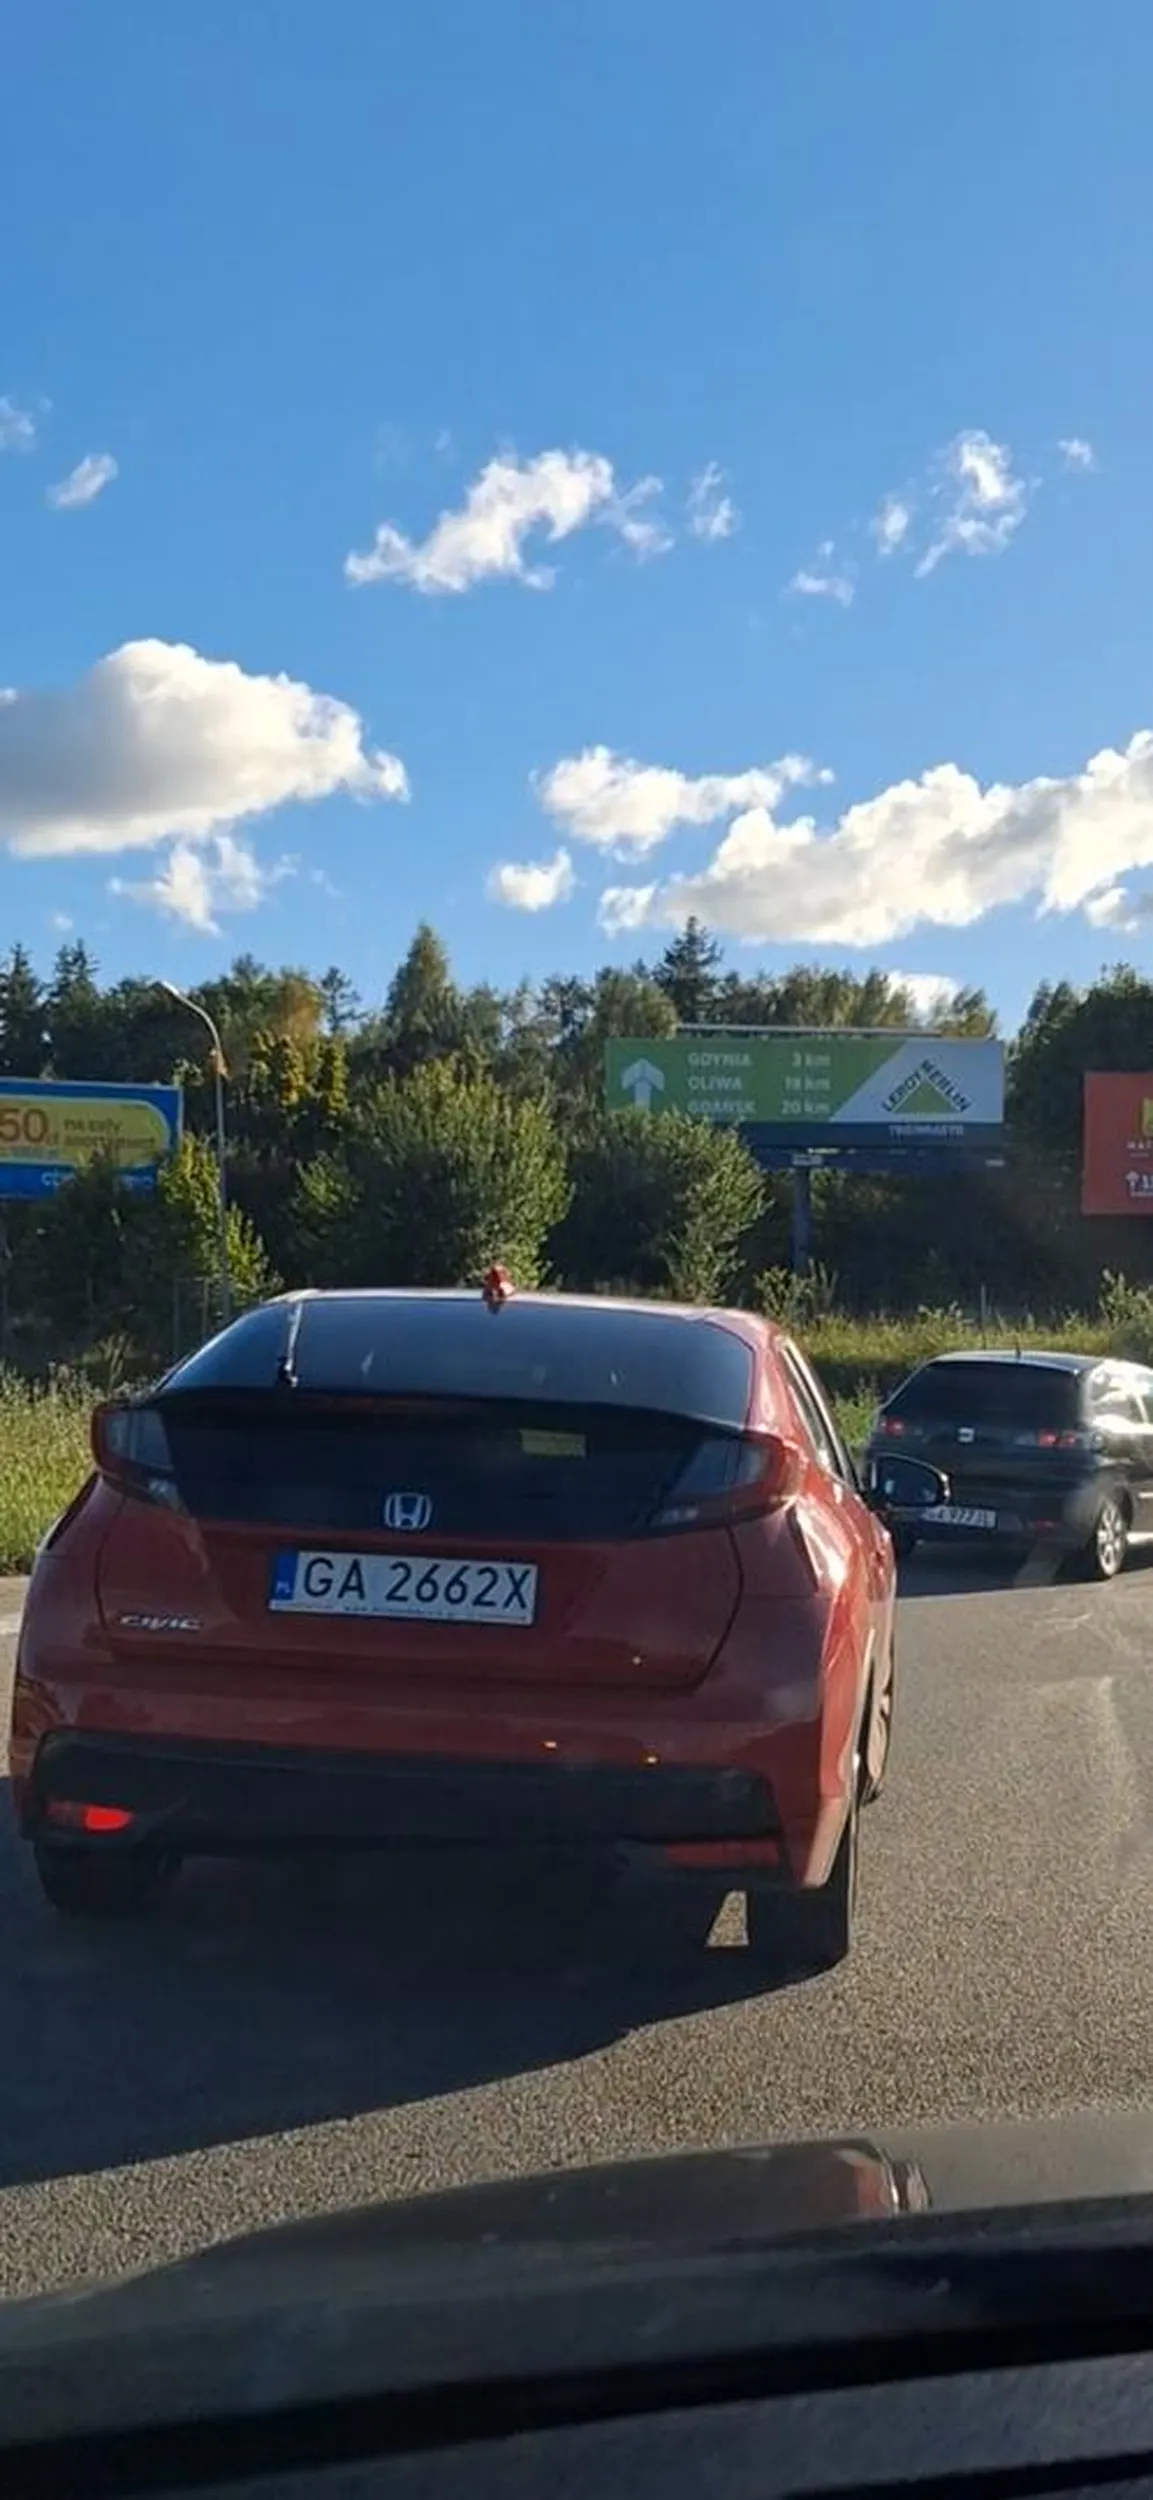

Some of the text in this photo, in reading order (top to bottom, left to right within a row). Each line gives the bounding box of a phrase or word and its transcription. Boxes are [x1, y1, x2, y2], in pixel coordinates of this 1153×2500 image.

[687, 1051, 831, 1067] GDYNIA 3 km
[687, 1075, 742, 1090] OLIWA
[805, 1075, 831, 1090] km
[881, 1059, 973, 1113] LEROY MERLIN
[781, 1099, 801, 1115] 20
[805, 1099, 831, 1113] km
[303, 1557, 532, 1610] GA 2662X
[120, 1614, 203, 1631] CIVIC
